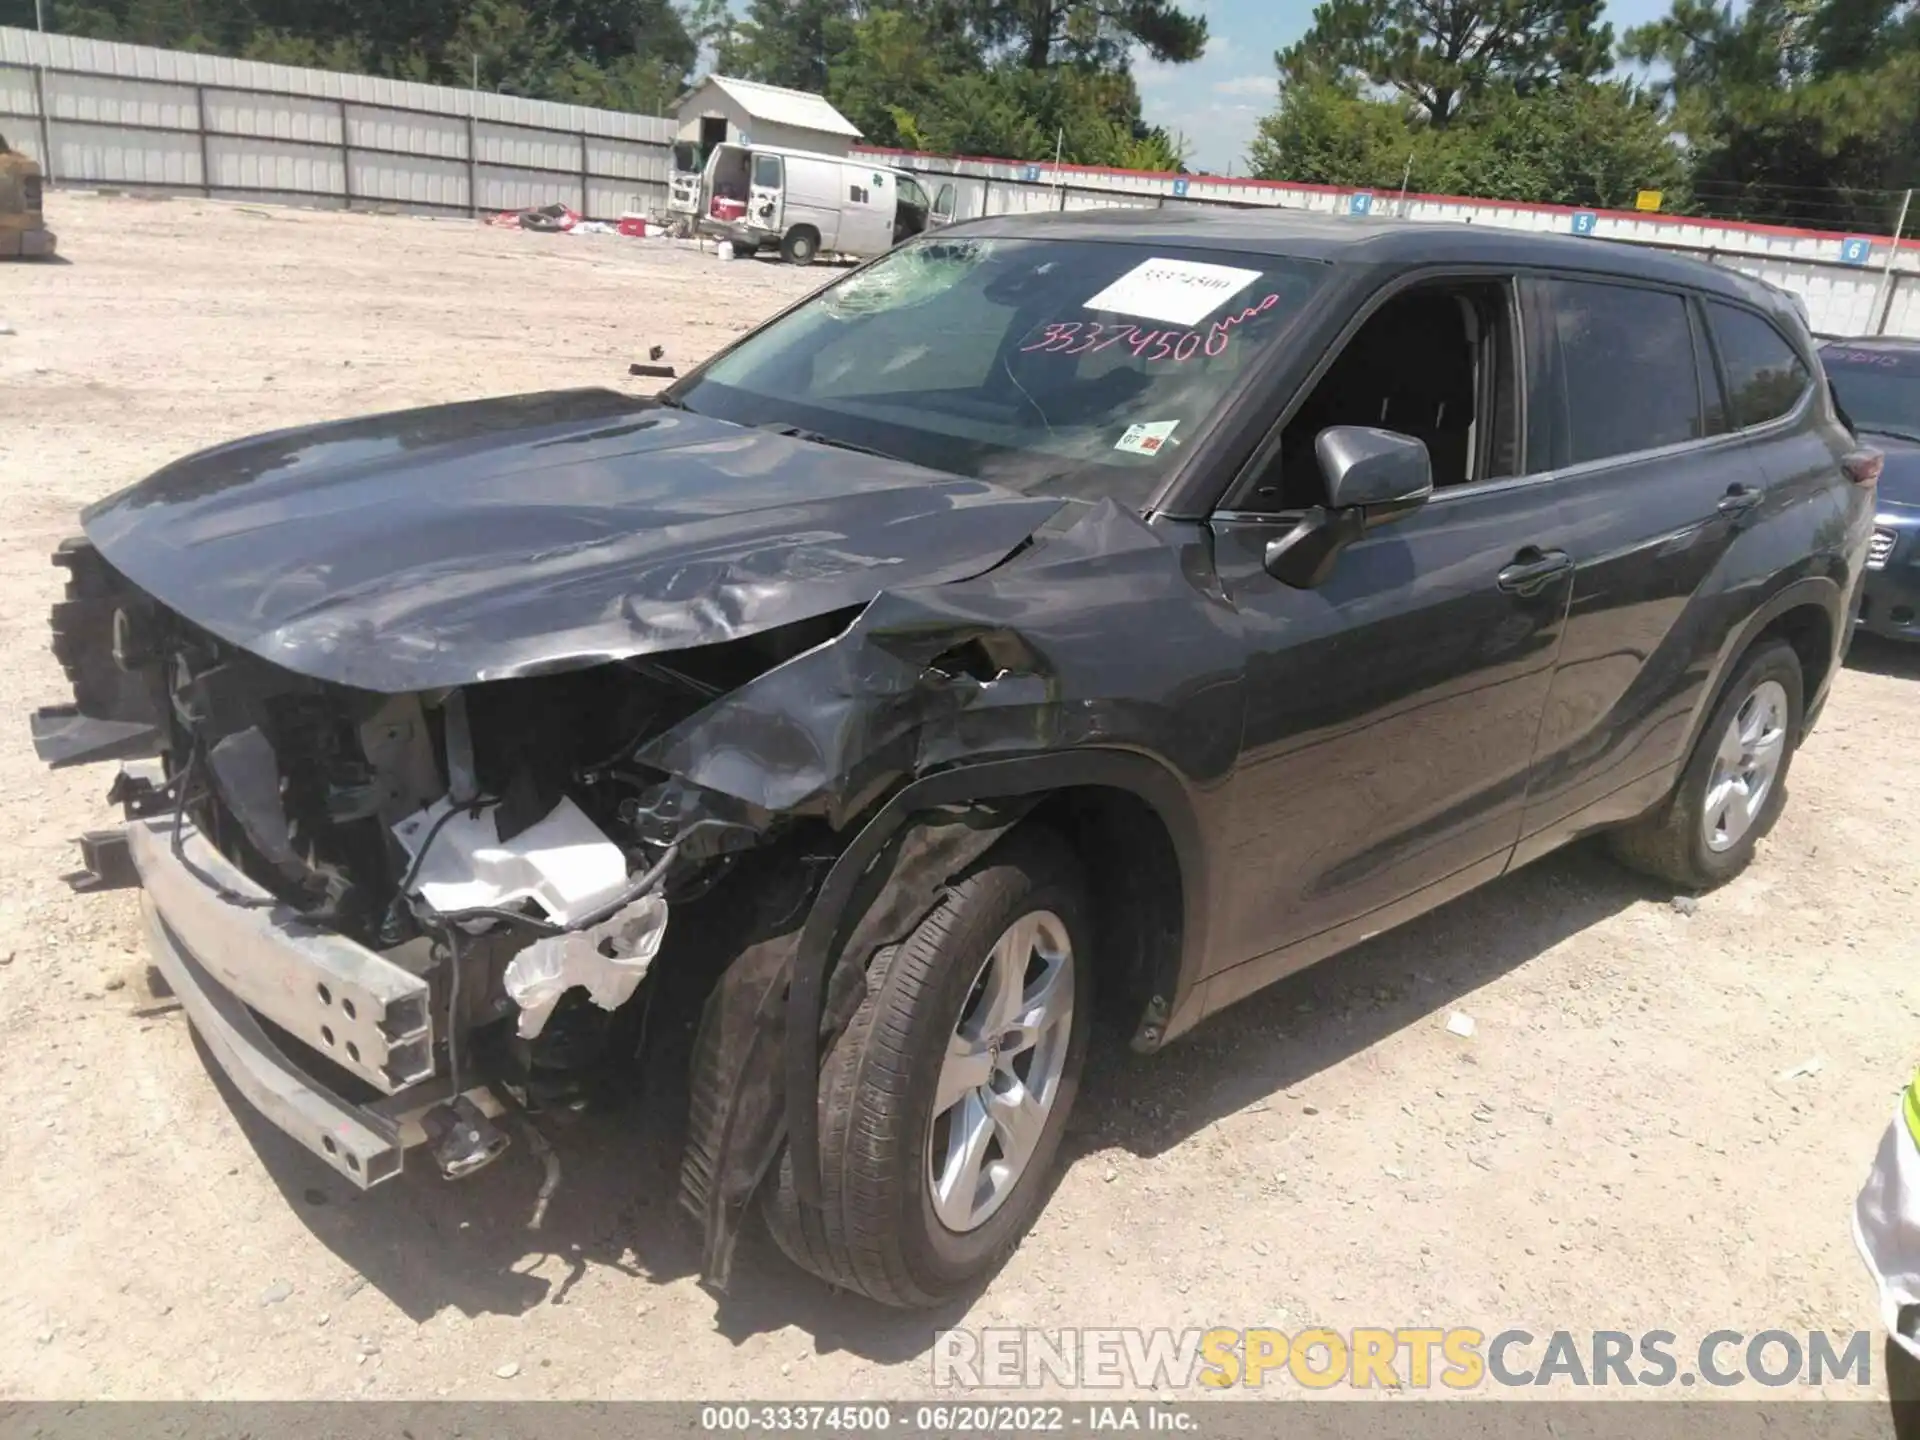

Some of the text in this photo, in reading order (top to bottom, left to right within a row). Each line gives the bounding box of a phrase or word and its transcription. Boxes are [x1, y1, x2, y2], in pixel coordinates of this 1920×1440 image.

[1354, 196, 1365, 211] 4
[1578, 215, 1588, 231] 5
[1848, 242, 1861, 259] 6
